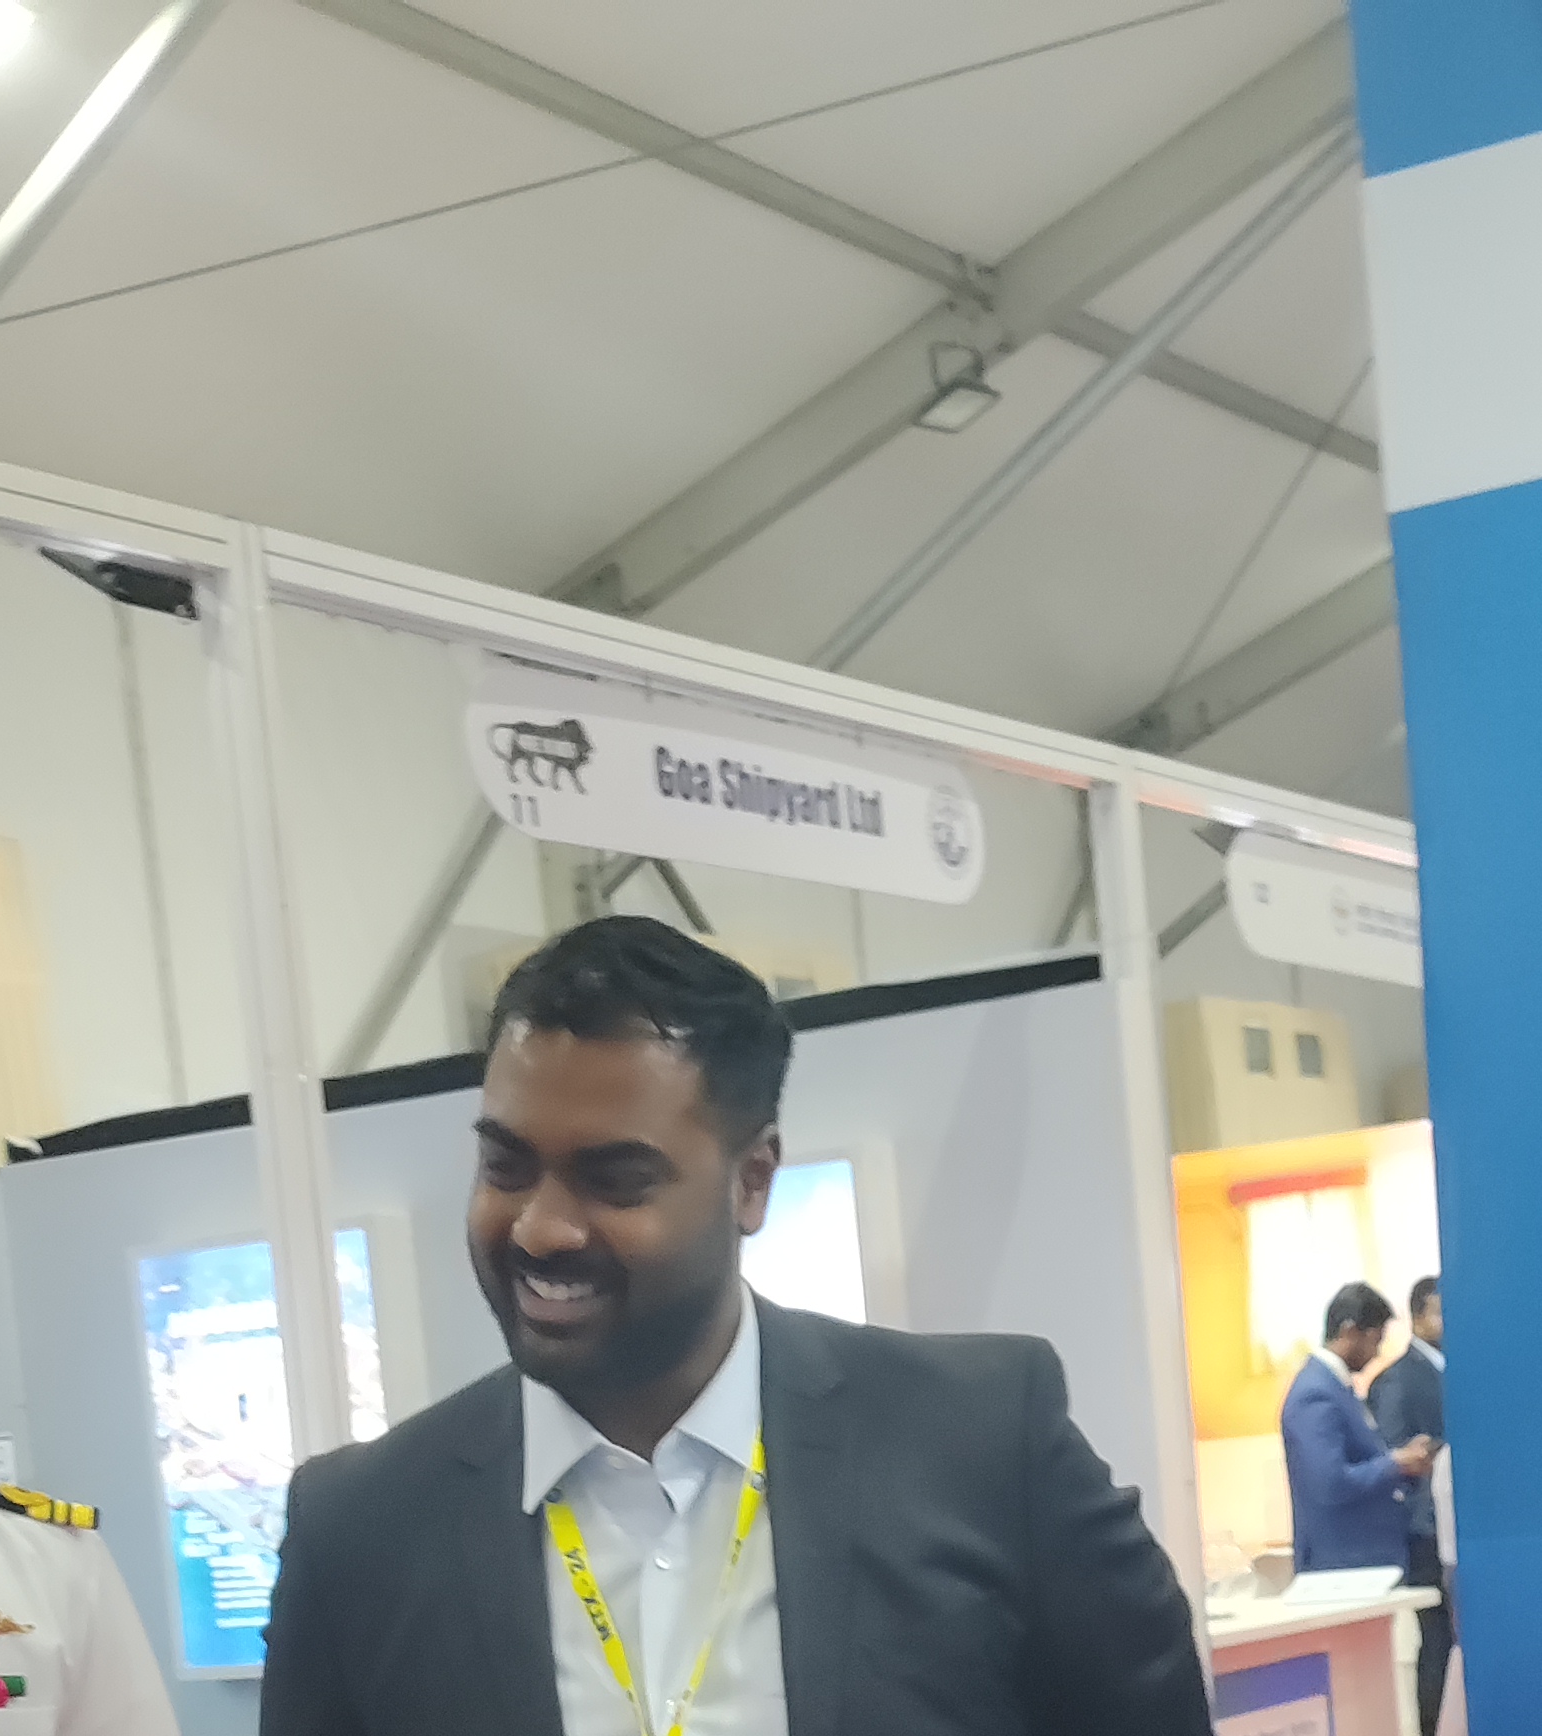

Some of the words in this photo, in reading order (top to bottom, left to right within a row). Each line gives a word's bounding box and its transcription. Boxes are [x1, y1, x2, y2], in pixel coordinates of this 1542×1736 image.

[510, 792, 541, 827] 11
[654, 745, 712, 804] Goa
[718, 757, 842, 828] Shipyard
[846, 783, 884, 837] Ltd
